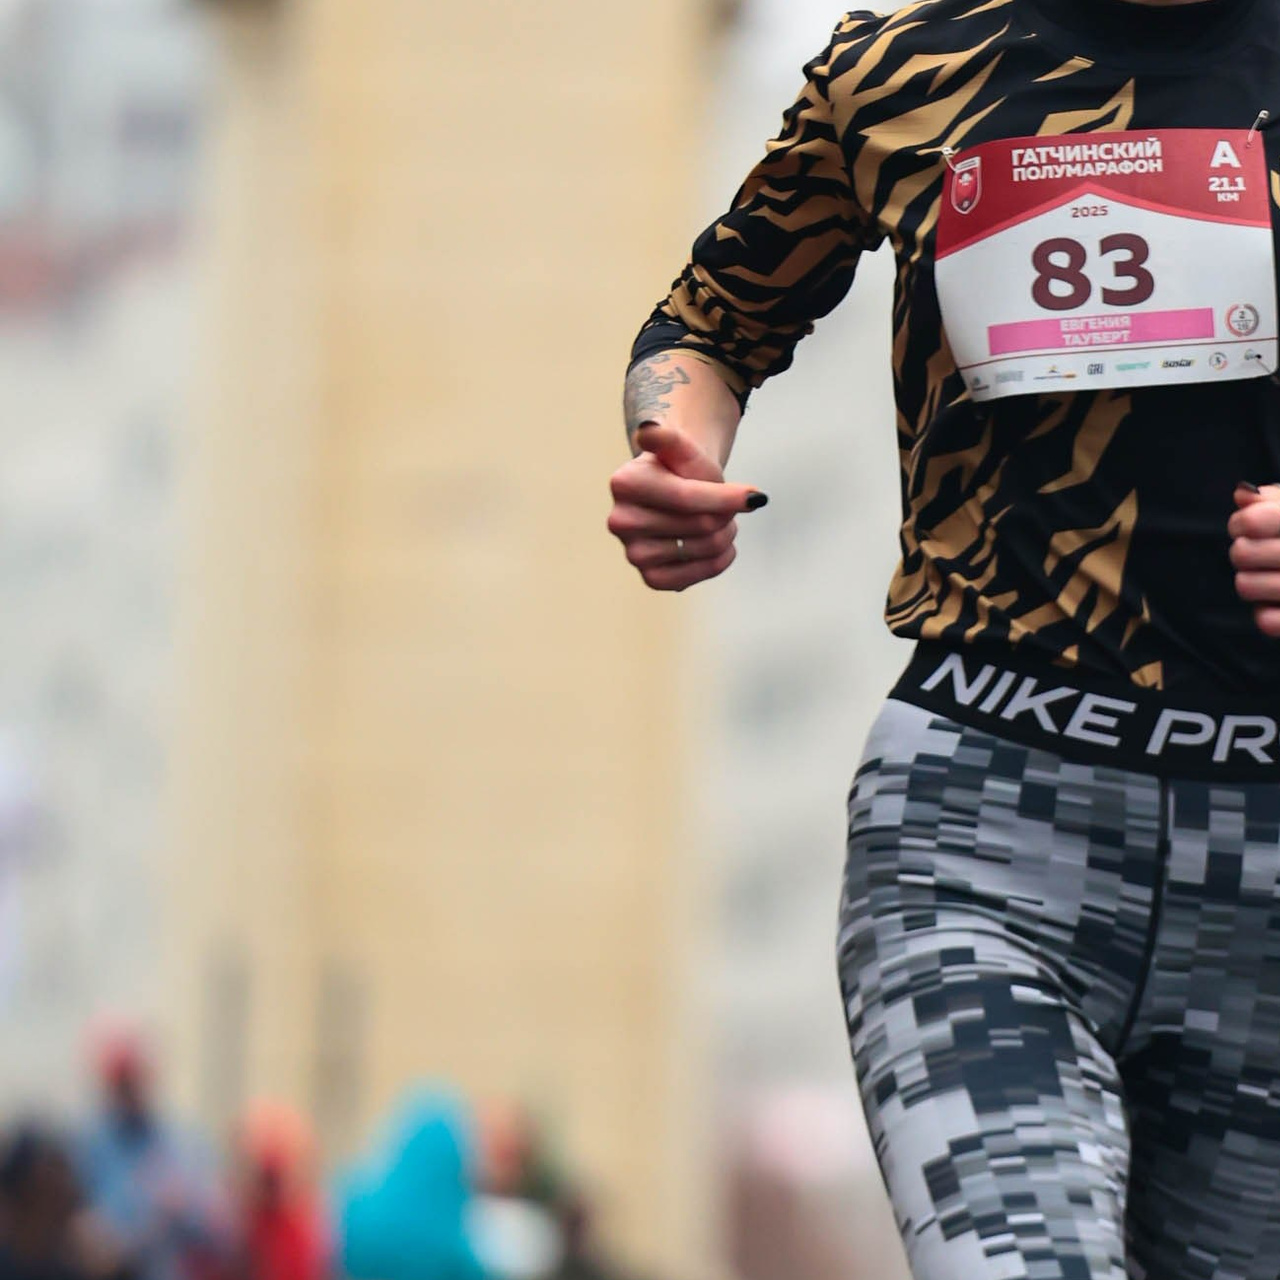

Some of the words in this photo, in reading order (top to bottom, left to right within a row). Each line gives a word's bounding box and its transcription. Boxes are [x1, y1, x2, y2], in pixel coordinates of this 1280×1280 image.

[1011, 137, 1162, 166] ГАТЧИНСКИЙ
[1012, 158, 1163, 181] ПОЛУМАРАФОН
[1208, 177, 1246, 191] 21.1
[1072, 205, 1109, 218] 2025
[1032, 233, 1154, 310] 83
[1060, 315, 1131, 332] ЕВГЕНИЯ
[1062, 329, 1131, 346] ТАУБЕРТ
[920, 653, 1138, 746] NIKE
